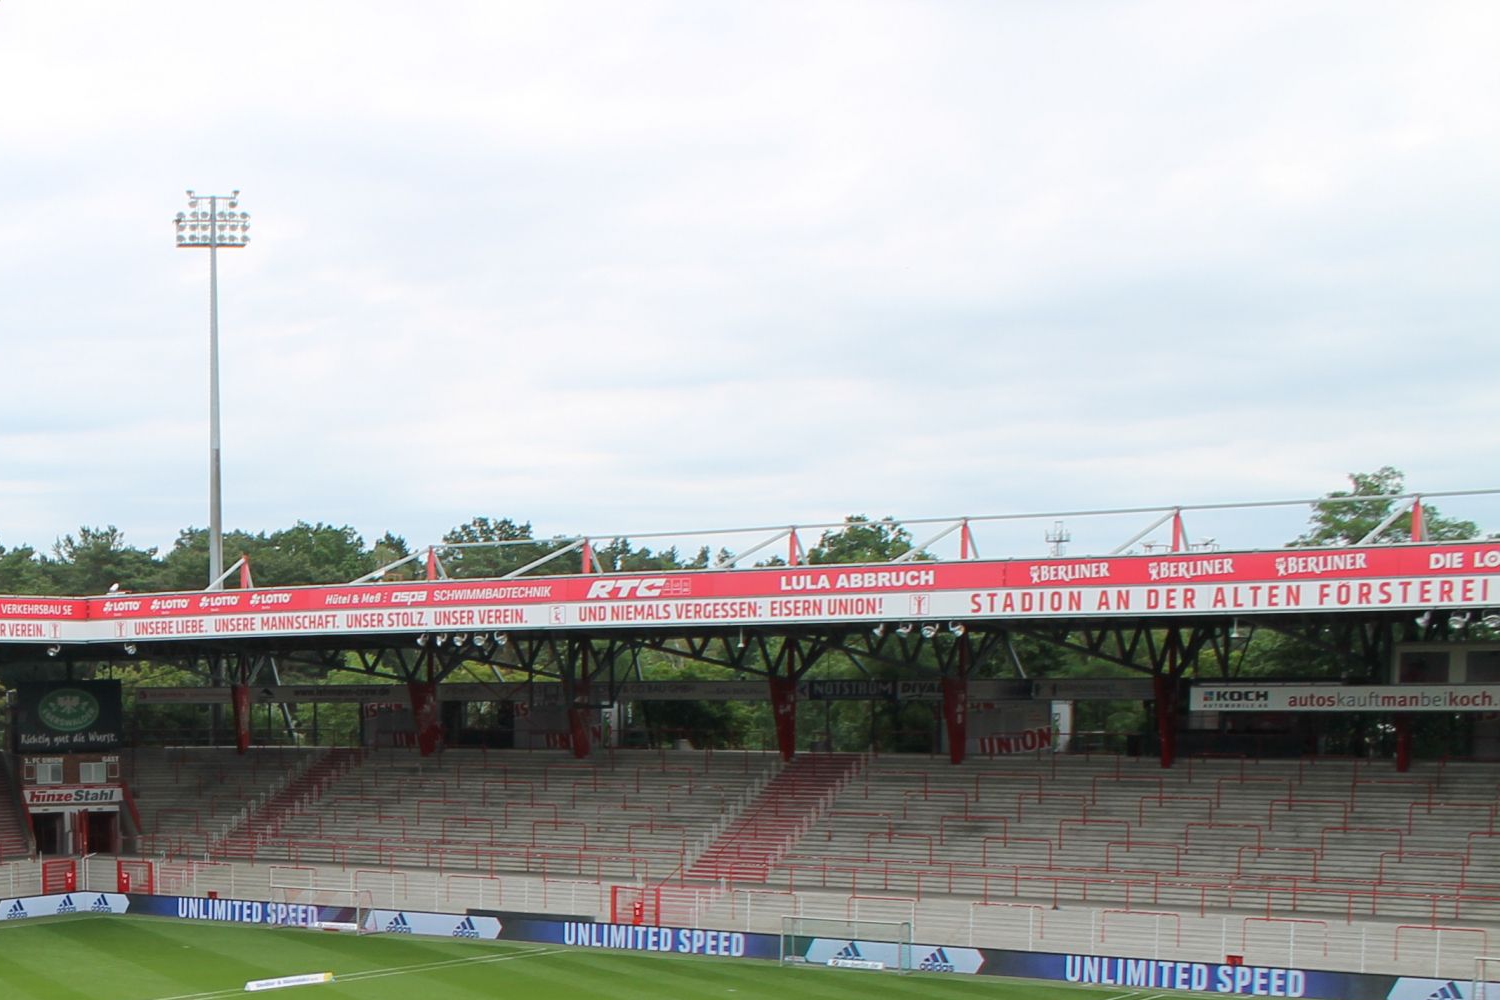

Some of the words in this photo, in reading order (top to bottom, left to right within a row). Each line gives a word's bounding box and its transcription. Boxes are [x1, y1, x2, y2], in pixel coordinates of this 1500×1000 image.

[1158, 558, 1234, 580] BERLINER
[1286, 553, 1367, 575] BERLINER
[1429, 552, 1464, 570] DIE
[781, 575, 830, 592] LULA
[835, 570, 935, 589] ABBRUCH
[1039, 561, 1110, 582] BERLINER
[113, 600, 142, 612] LOTTO
[160, 598, 190, 610] LOTTO
[209, 596, 240, 608] LOTTO
[260, 593, 292, 605] LOTTO
[391, 591, 428, 606] ospa
[433, 586, 552, 602] SCHWIMMBADTECHNIK
[971, 590, 1082, 614] STADION
[1097, 589, 1132, 611] AN
[1146, 588, 1197, 610] DER
[1212, 585, 1301, 609] ALTEN
[1318, 579, 1489, 607] FÖRSTEREI
[1, 603, 61, 615] VERKEHRSBAU
[61, 605, 73, 616] SE
[578, 604, 605, 622] UND
[611, 602, 671, 621] NIEMALS
[676, 600, 762, 620] VERGESSEN:
[769, 599, 823, 618] EISERN
[827, 597, 884, 616] UNION!
[9, 623, 46, 638] VEREIN.
[134, 620, 174, 636] UNSERE
[176, 619, 209, 634] LIEBE.
[214, 617, 256, 633] UNSERE
[260, 614, 340, 631] MANNSCHAFT.
[346, 611, 385, 628] UNSER
[388, 611, 428, 628] STOLZ.
[434, 609, 475, 627] UNSER
[478, 608, 529, 625] VEREIN.
[1216, 690, 1269, 702] KOCH
[178, 897, 262, 924] UNLIMITED
[266, 901, 319, 927] SPEED
[563, 921, 672, 953] UNLIMITED
[677, 929, 745, 958] SPEED
[919, 962, 955, 973] adidas
[1064, 954, 1208, 992] UNLIMITED
[1216, 963, 1305, 998] SPEED
